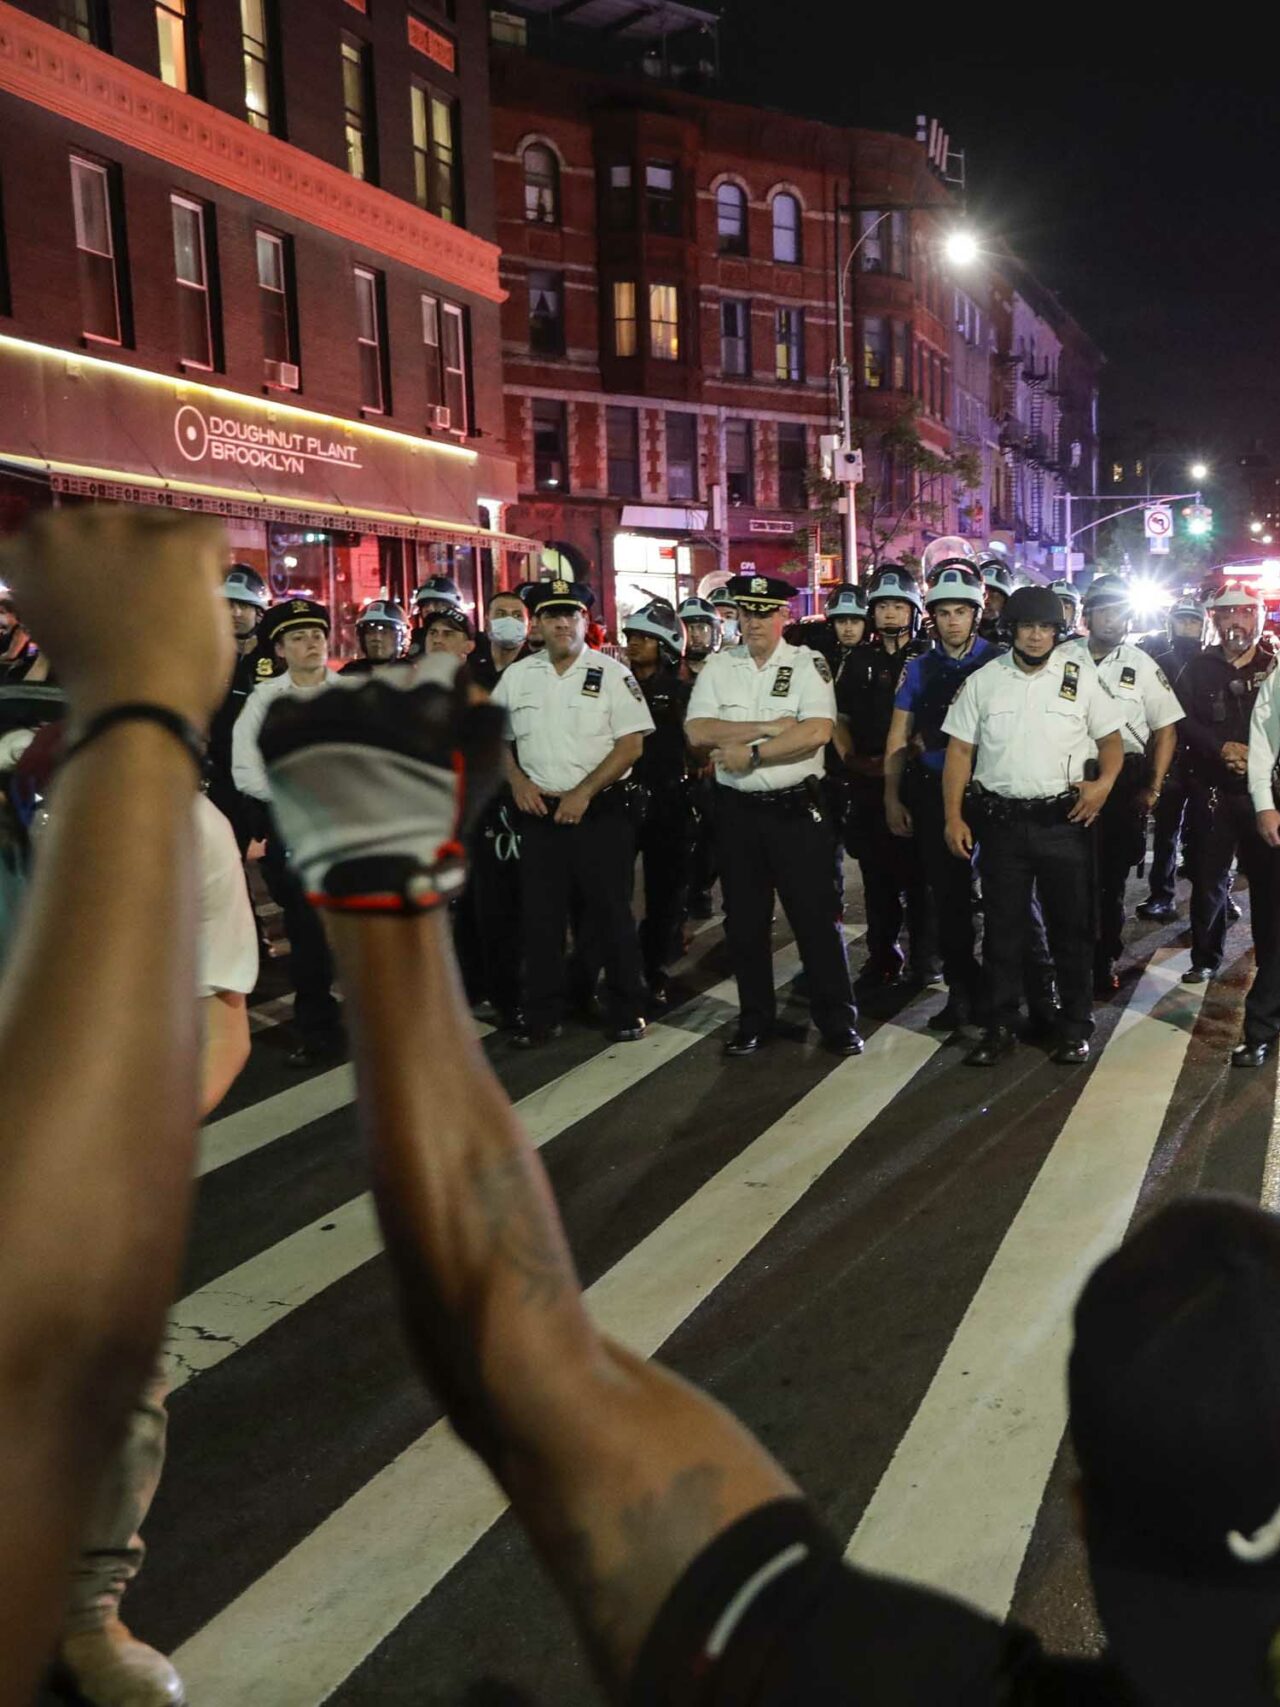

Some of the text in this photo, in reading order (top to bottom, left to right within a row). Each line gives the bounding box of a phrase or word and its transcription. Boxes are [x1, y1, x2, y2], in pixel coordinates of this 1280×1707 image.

[209, 416, 357, 461] DOUGHNUT PLANT
[210, 442, 304, 474] BROOKLYN
